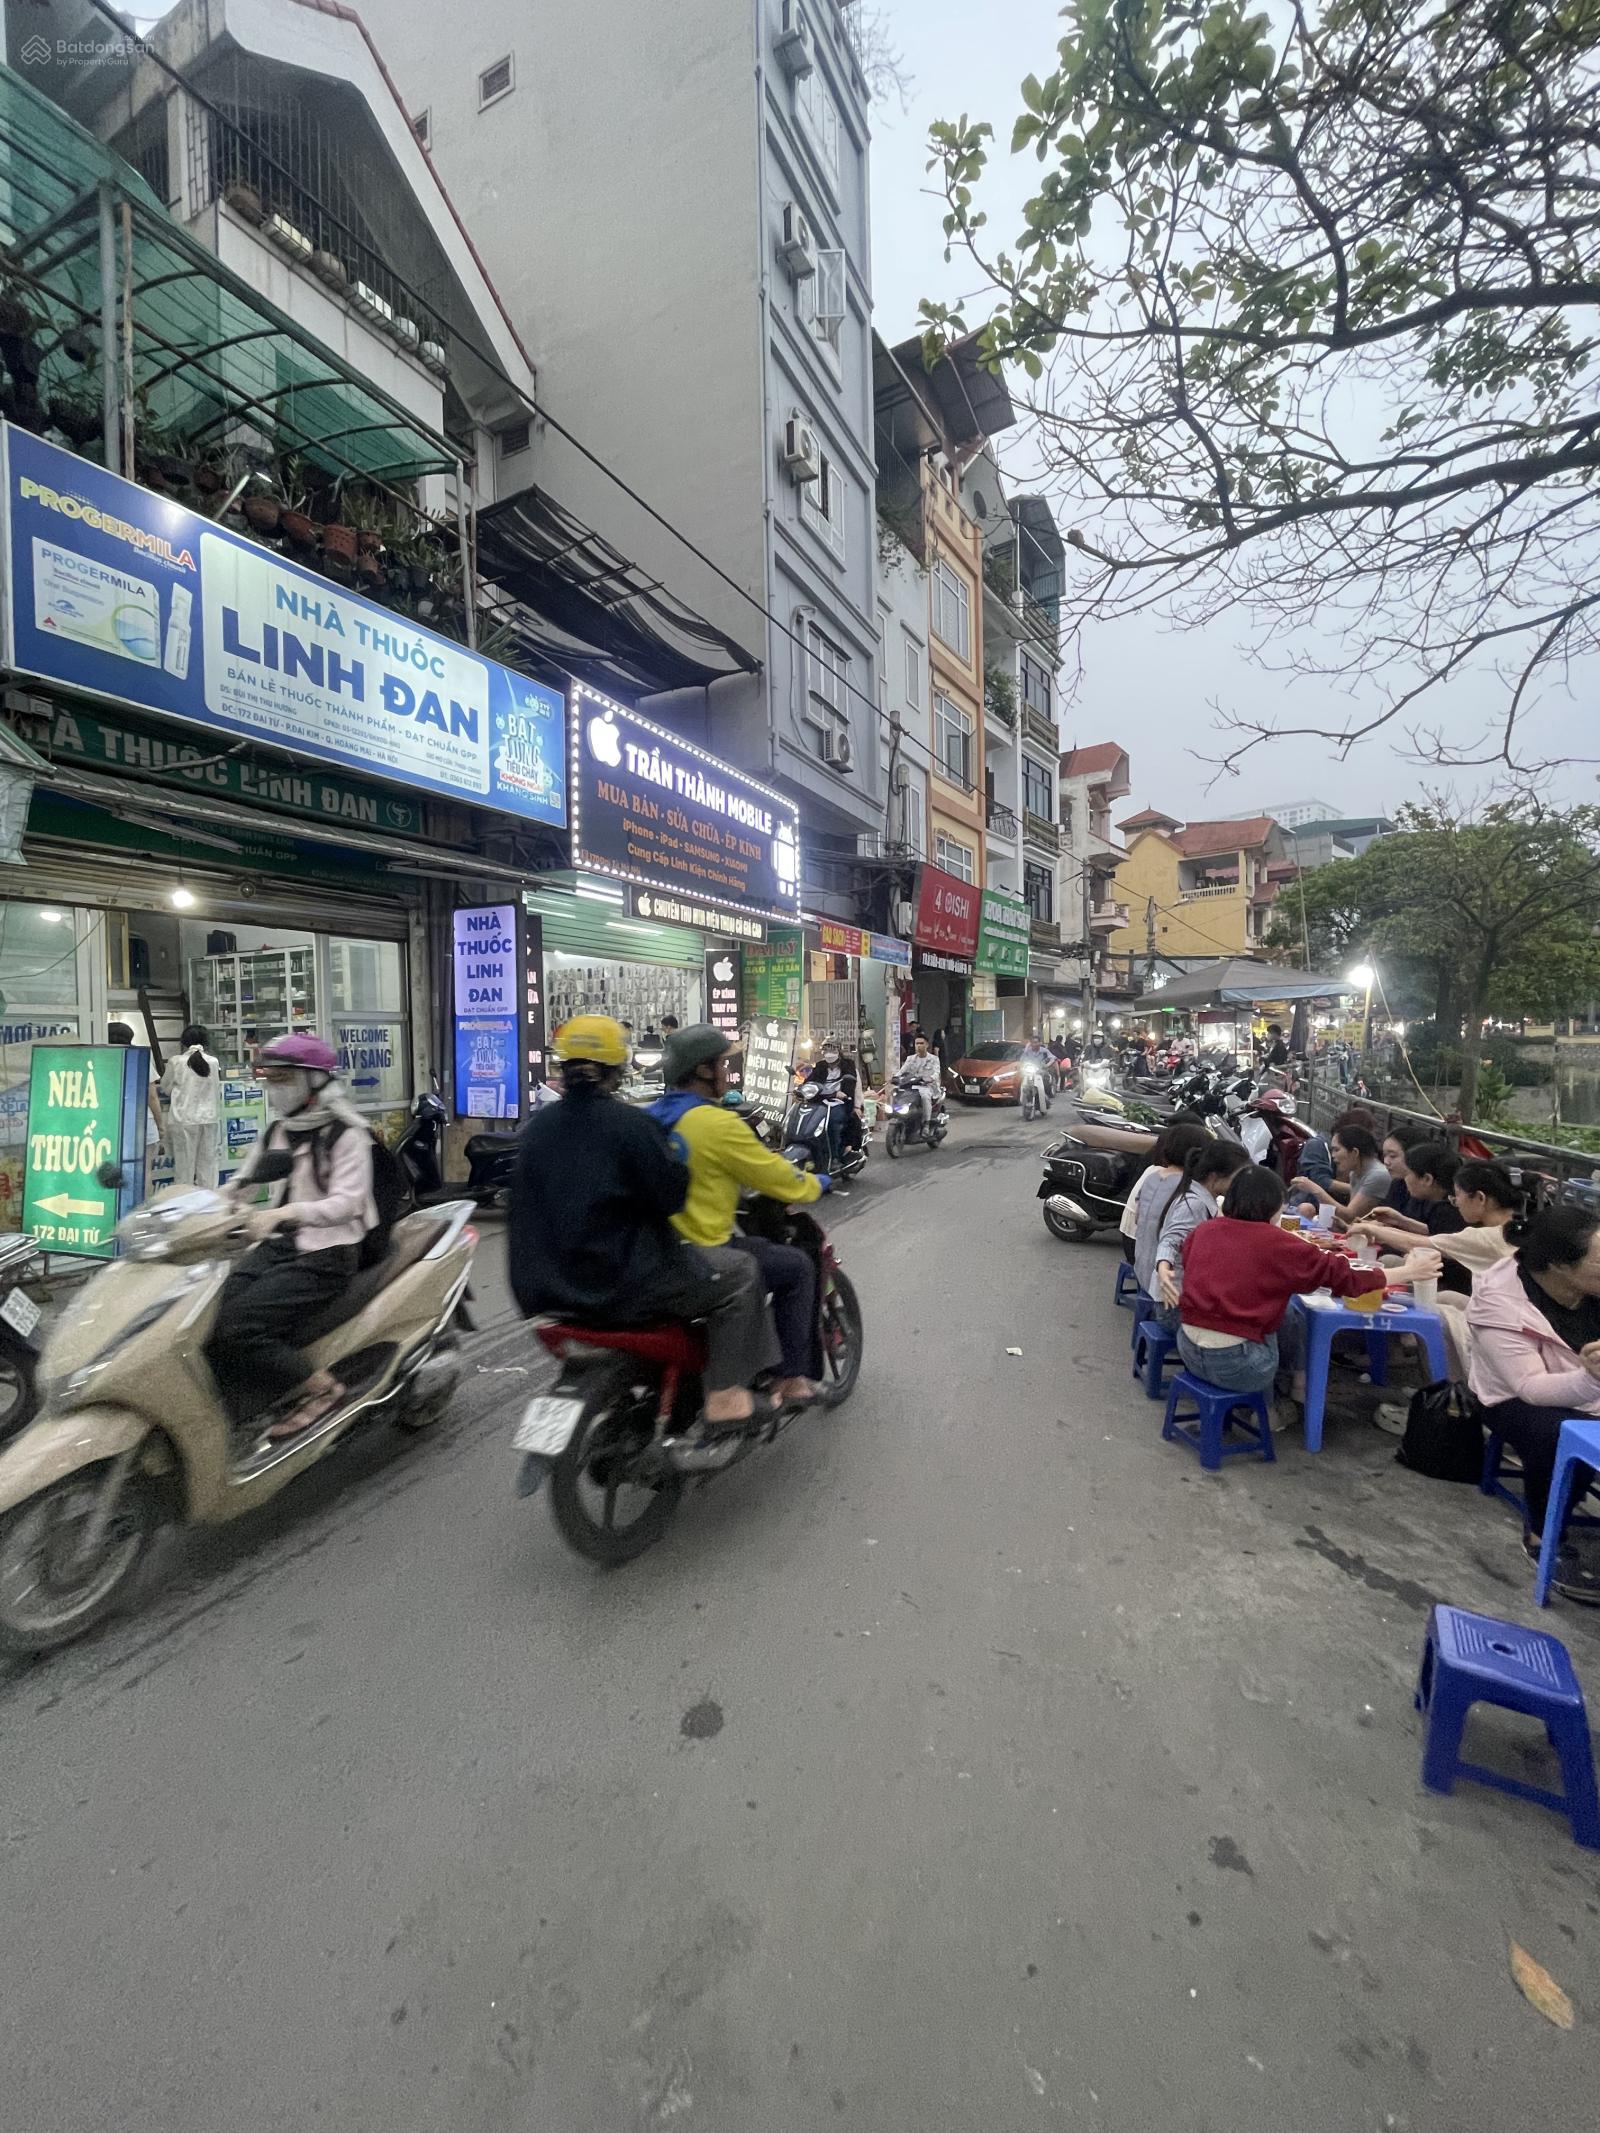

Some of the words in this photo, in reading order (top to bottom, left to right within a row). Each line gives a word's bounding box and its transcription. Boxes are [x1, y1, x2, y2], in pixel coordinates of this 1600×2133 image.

[20, 476, 197, 572] PROGERMILA
[41, 547, 146, 598] PROGERMILA
[276, 583, 345, 637] NHÀ
[354, 619, 445, 679] THUỐC
[222, 605, 364, 703] LINH
[379, 671, 479, 744] ĐAN
[227, 667, 256, 686] BÁN
[280, 686, 322, 709] THUỐC
[325, 701, 364, 724] THÀNH
[367, 715, 396, 734] PHẨM
[405, 729, 425, 743] ĐẠT
[427, 737, 459, 756] CHUẨN
[460, 748, 478, 761] GPP
[306, 728, 321, 740] KIM
[508, 713, 537, 744] BẬT
[240, 763, 312, 807] LINH
[321, 785, 378, 824] ĐAN
[625, 743, 674, 790] TRẦN
[675, 768, 725, 814] THÀNH
[727, 793, 772, 835] MOBILE
[597, 780, 629, 809] MUA
[632, 793, 659, 821] BÁN
[667, 805, 689, 833] SỬA
[691, 818, 720, 844] CHỮA
[725, 829, 737, 850] ÉP
[739, 838, 762, 861] KÍNH
[623, 818, 654, 840] iPhone
[660, 831, 679, 849] iPad
[684, 841, 720, 863] SAMSUNG
[725, 855, 748, 874] XIAOMI
[628, 842, 651, 864] Cung
[652, 850, 669, 868] Cấp
[671, 856, 689, 872] Linh
[689, 862, 707, 880] Kiện
[653, 897, 679, 920] CHUYÊN
[680, 904, 692, 923] THU
[934, 888, 943, 912] 4
[944, 891, 970, 920] OISHI
[467, 911, 502, 932] NHÀ
[457, 931, 513, 956] THUỐC
[777, 937, 797, 956] LÝ
[466, 963, 503, 979] LINH
[468, 986, 503, 1003] ĐAN
[712, 987, 721, 999] ÉP
[340, 1028, 389, 1043] WELCOME
[754, 1036, 770, 1050] THU
[770, 1039, 788, 1054] MUA
[361, 1048, 392, 1068] SANG
[746, 1053, 766, 1071] ĐIỆN
[47, 1060, 99, 1109] NHÀ
[744, 1072, 757, 1087] CŨ
[757, 1074, 770, 1090] GIÁ
[771, 1079, 788, 1094] CAO
[747, 1090, 760, 1103] ÉP
[760, 1092, 782, 1107] KÍNH
[31, 1119, 111, 1175] THUỐC
[33, 1224, 55, 1240] 172
[58, 1226, 79, 1245] ĐẠI
[83, 1226, 101, 1244] TỪ
